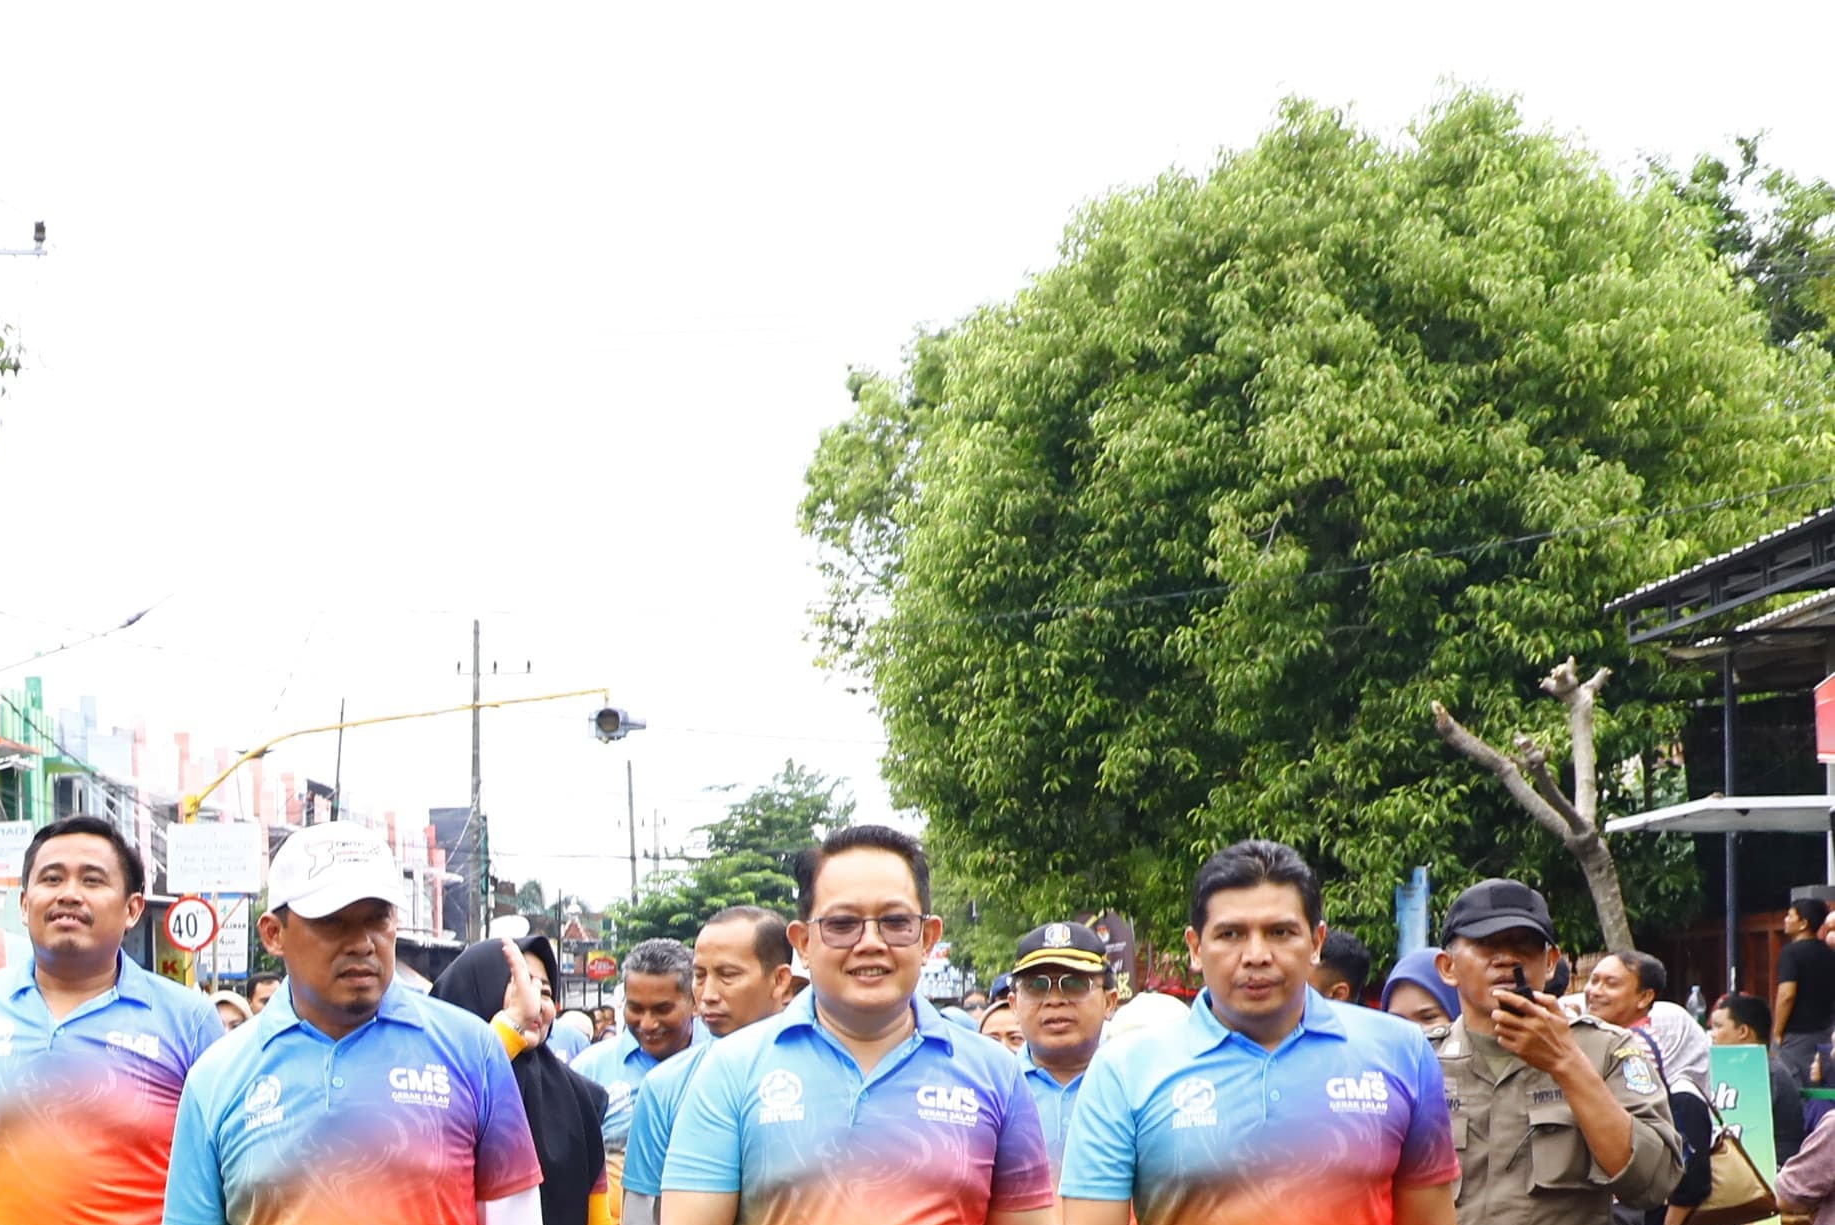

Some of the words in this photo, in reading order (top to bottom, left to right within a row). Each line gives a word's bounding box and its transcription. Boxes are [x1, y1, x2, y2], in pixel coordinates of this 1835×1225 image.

[172, 911, 198, 938] 40
[389, 1067, 451, 1095] GMS
[1326, 1077, 1389, 1102] GMS
[916, 1085, 980, 1113] GMS
